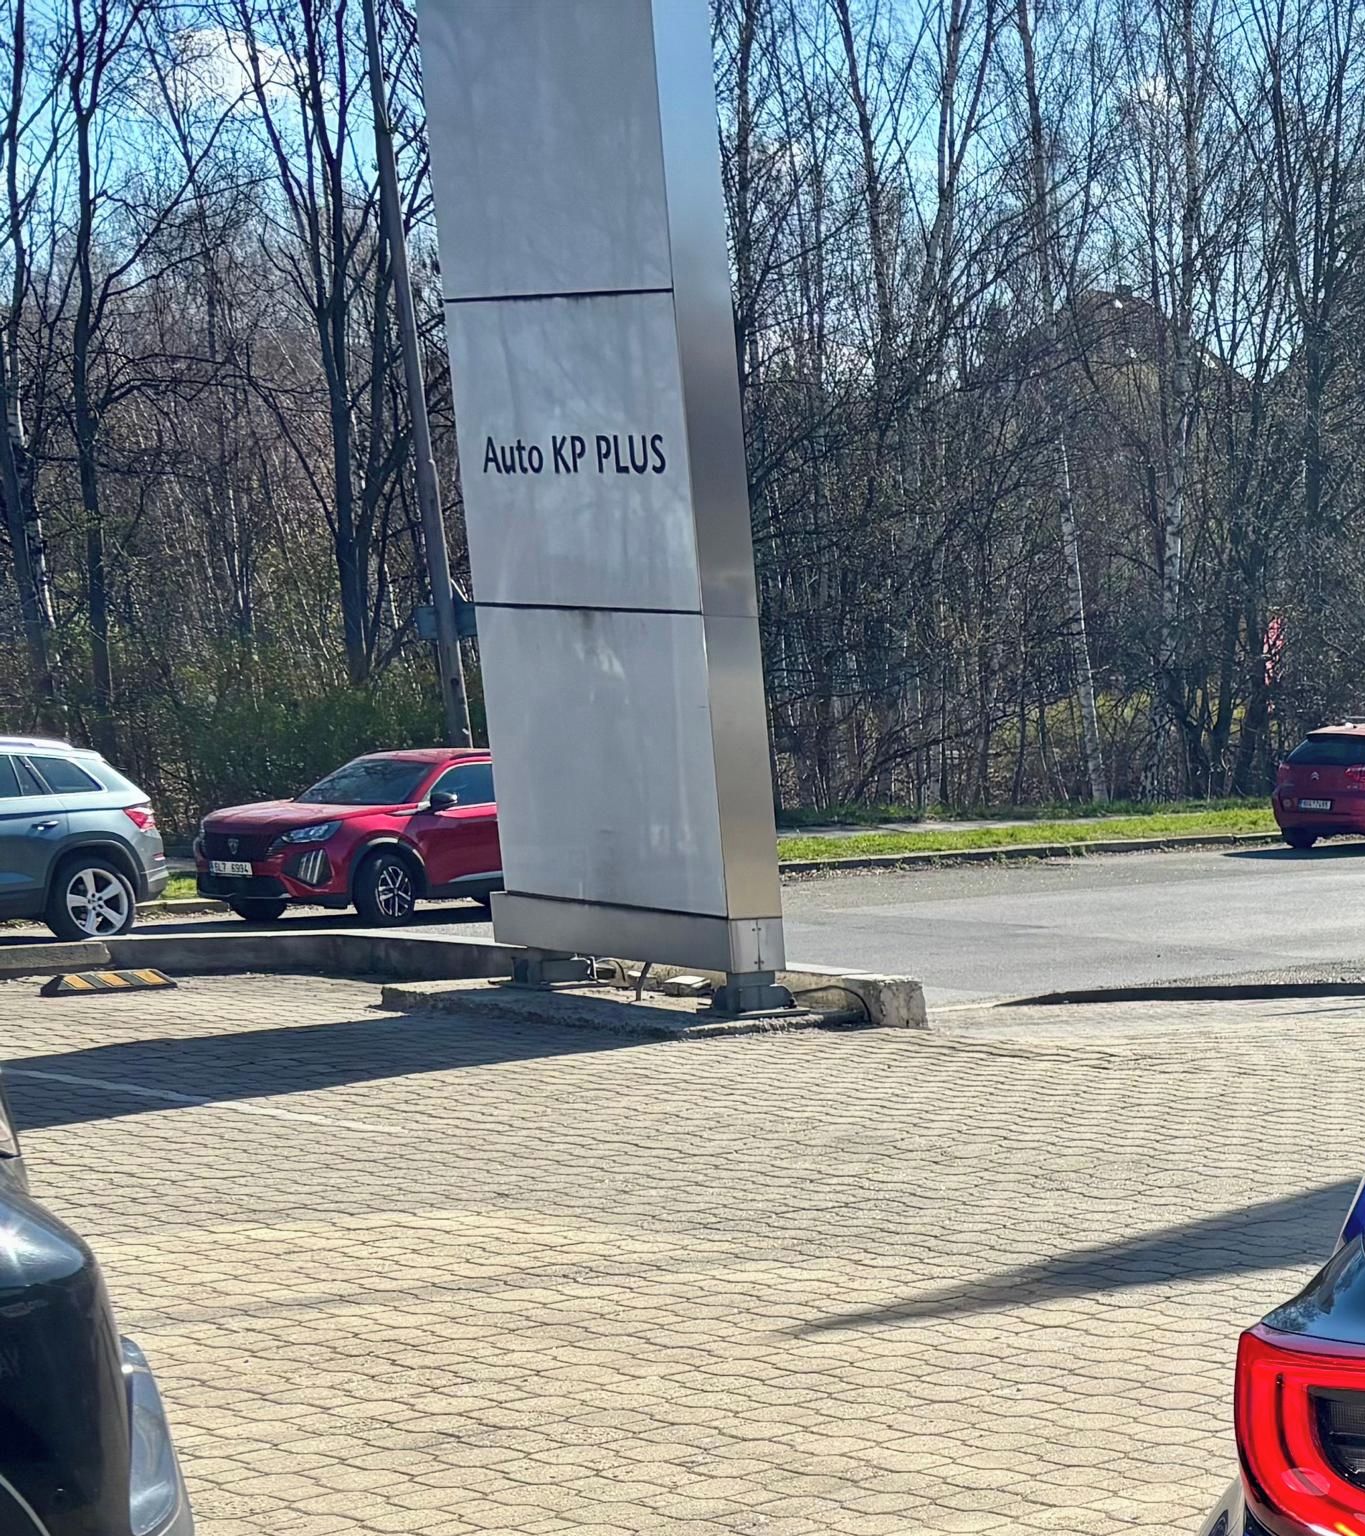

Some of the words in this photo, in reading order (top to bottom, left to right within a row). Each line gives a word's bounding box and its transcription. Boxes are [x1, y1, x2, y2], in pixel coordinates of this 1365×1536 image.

[483, 436, 544, 475] Auto
[551, 435, 586, 474] KP
[595, 434, 667, 474] PLUS
